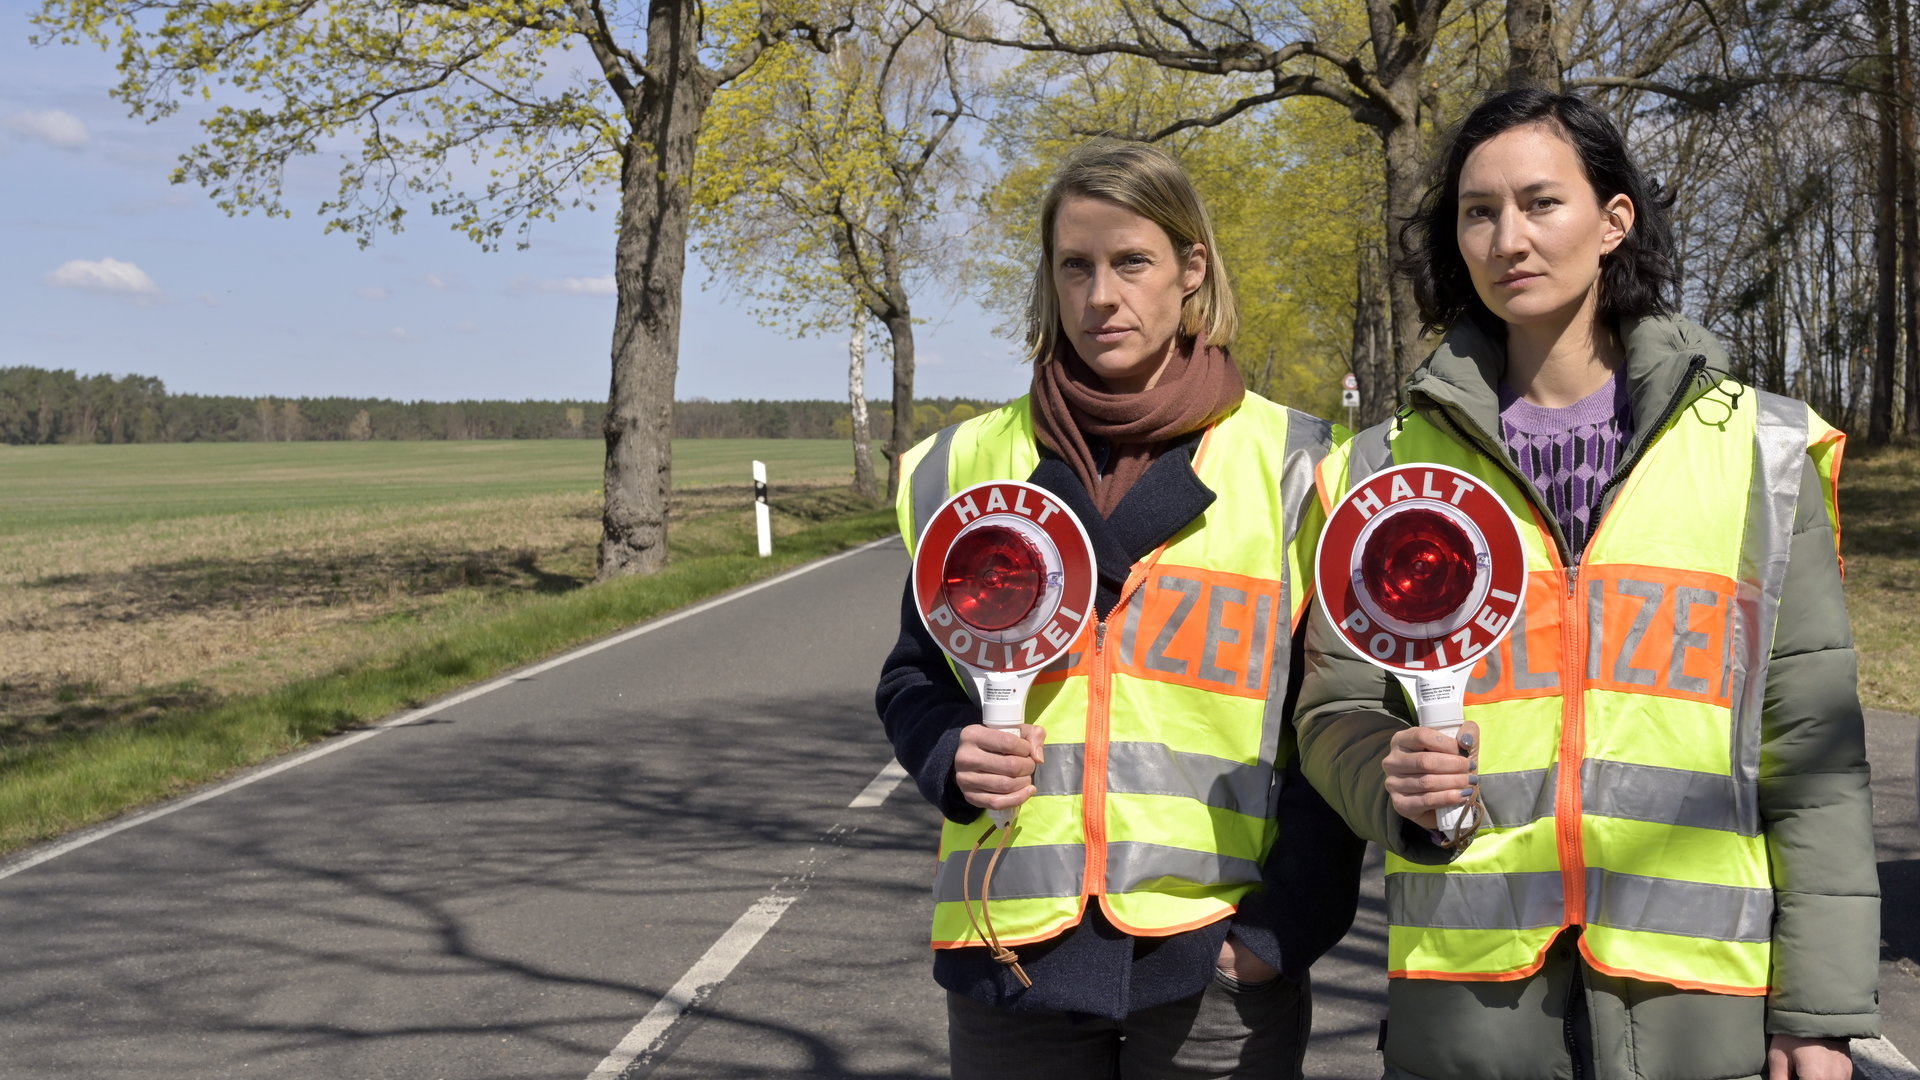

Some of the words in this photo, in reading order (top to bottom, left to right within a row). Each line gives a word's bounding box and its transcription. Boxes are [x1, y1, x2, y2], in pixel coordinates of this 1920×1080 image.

[953, 487, 1060, 525] HALT
[1351, 471, 1475, 520] HALT
[927, 604, 1082, 669] POLIZEI
[1340, 588, 1518, 669] POLIZEI
